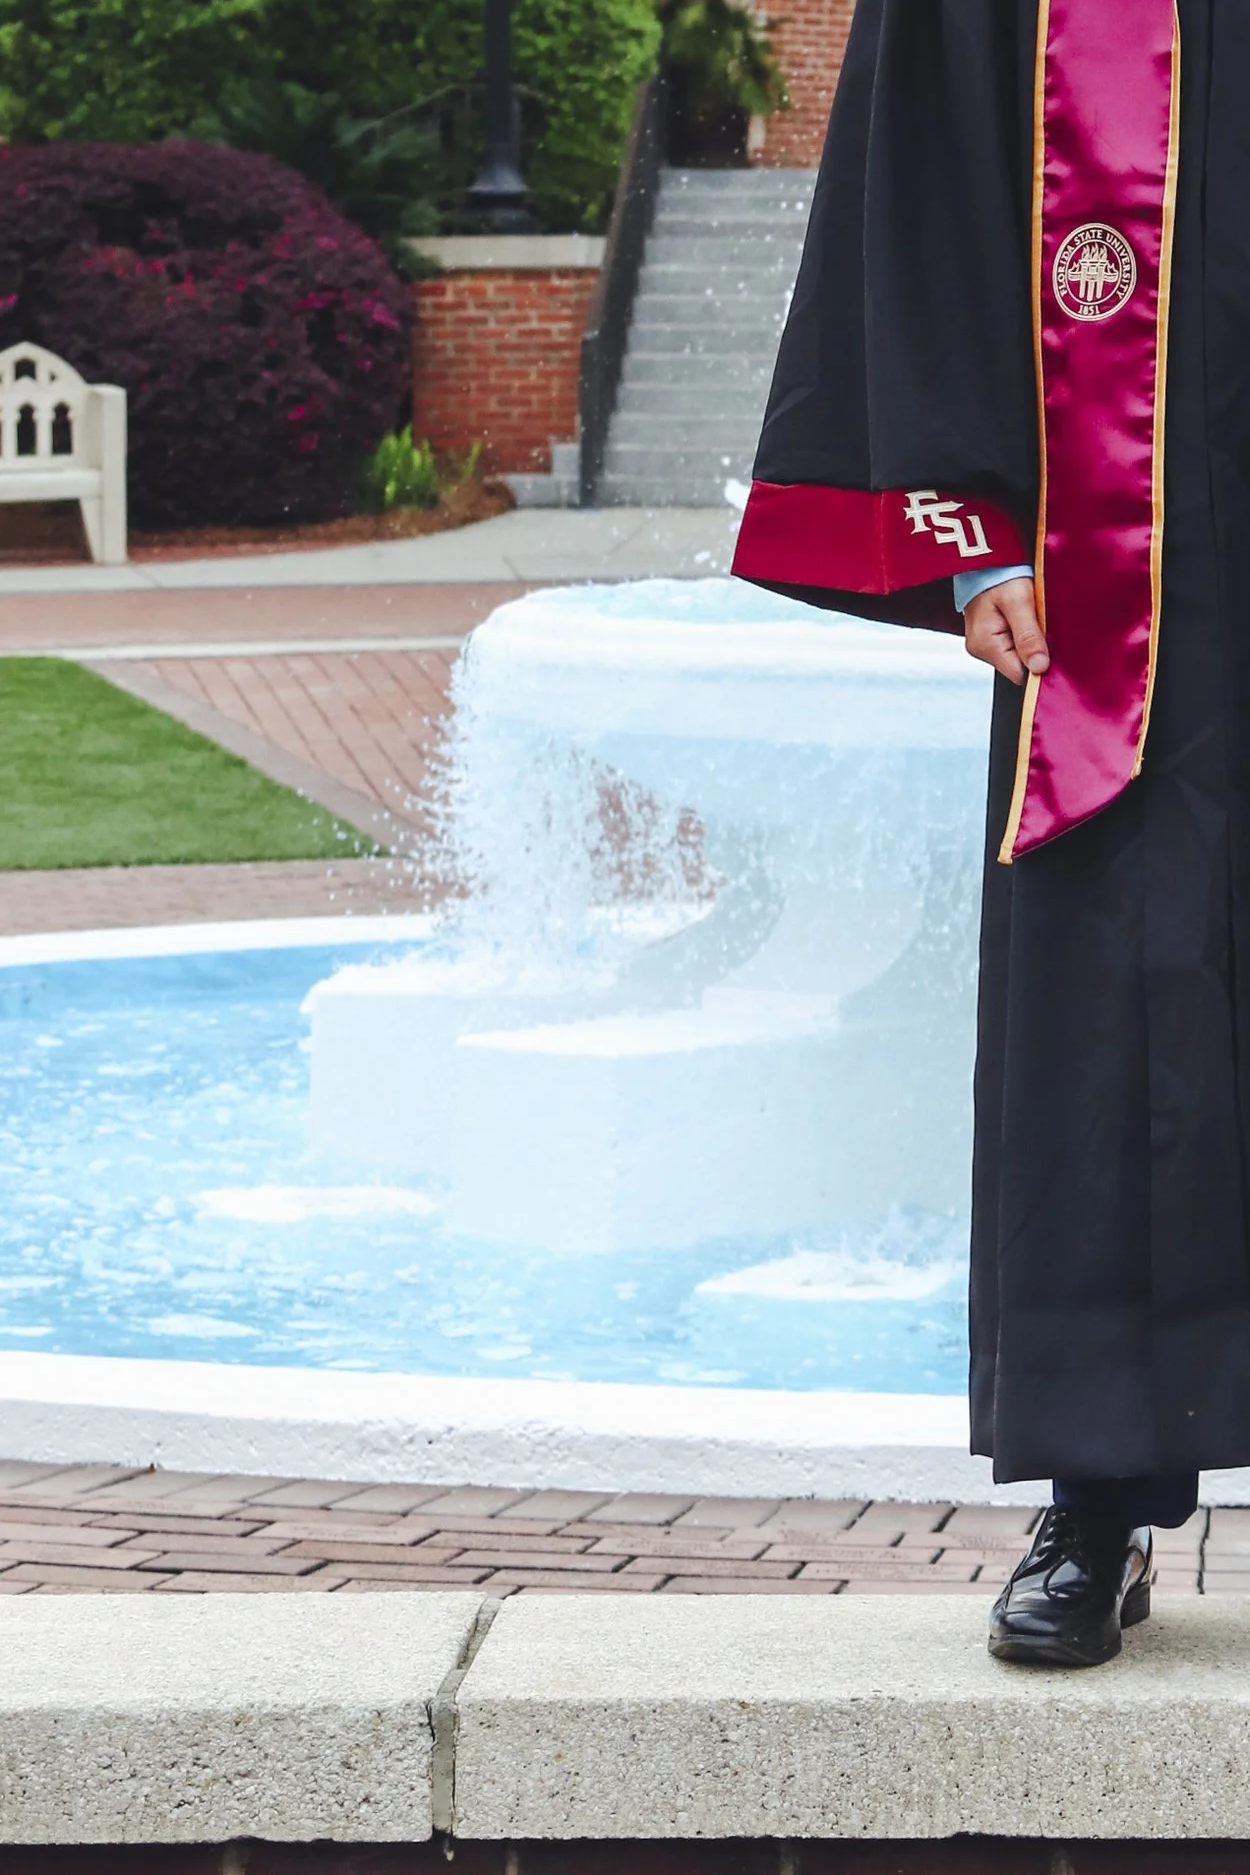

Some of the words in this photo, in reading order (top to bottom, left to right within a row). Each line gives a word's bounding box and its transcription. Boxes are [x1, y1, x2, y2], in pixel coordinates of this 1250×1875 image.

[1057, 245, 1075, 297] FLORIDA
[1074, 229, 1103, 245] STATE
[1106, 233, 1131, 299] UNIVERSITY
[1077, 304, 1100, 316] 1851
[903, 489, 993, 558] FSU
